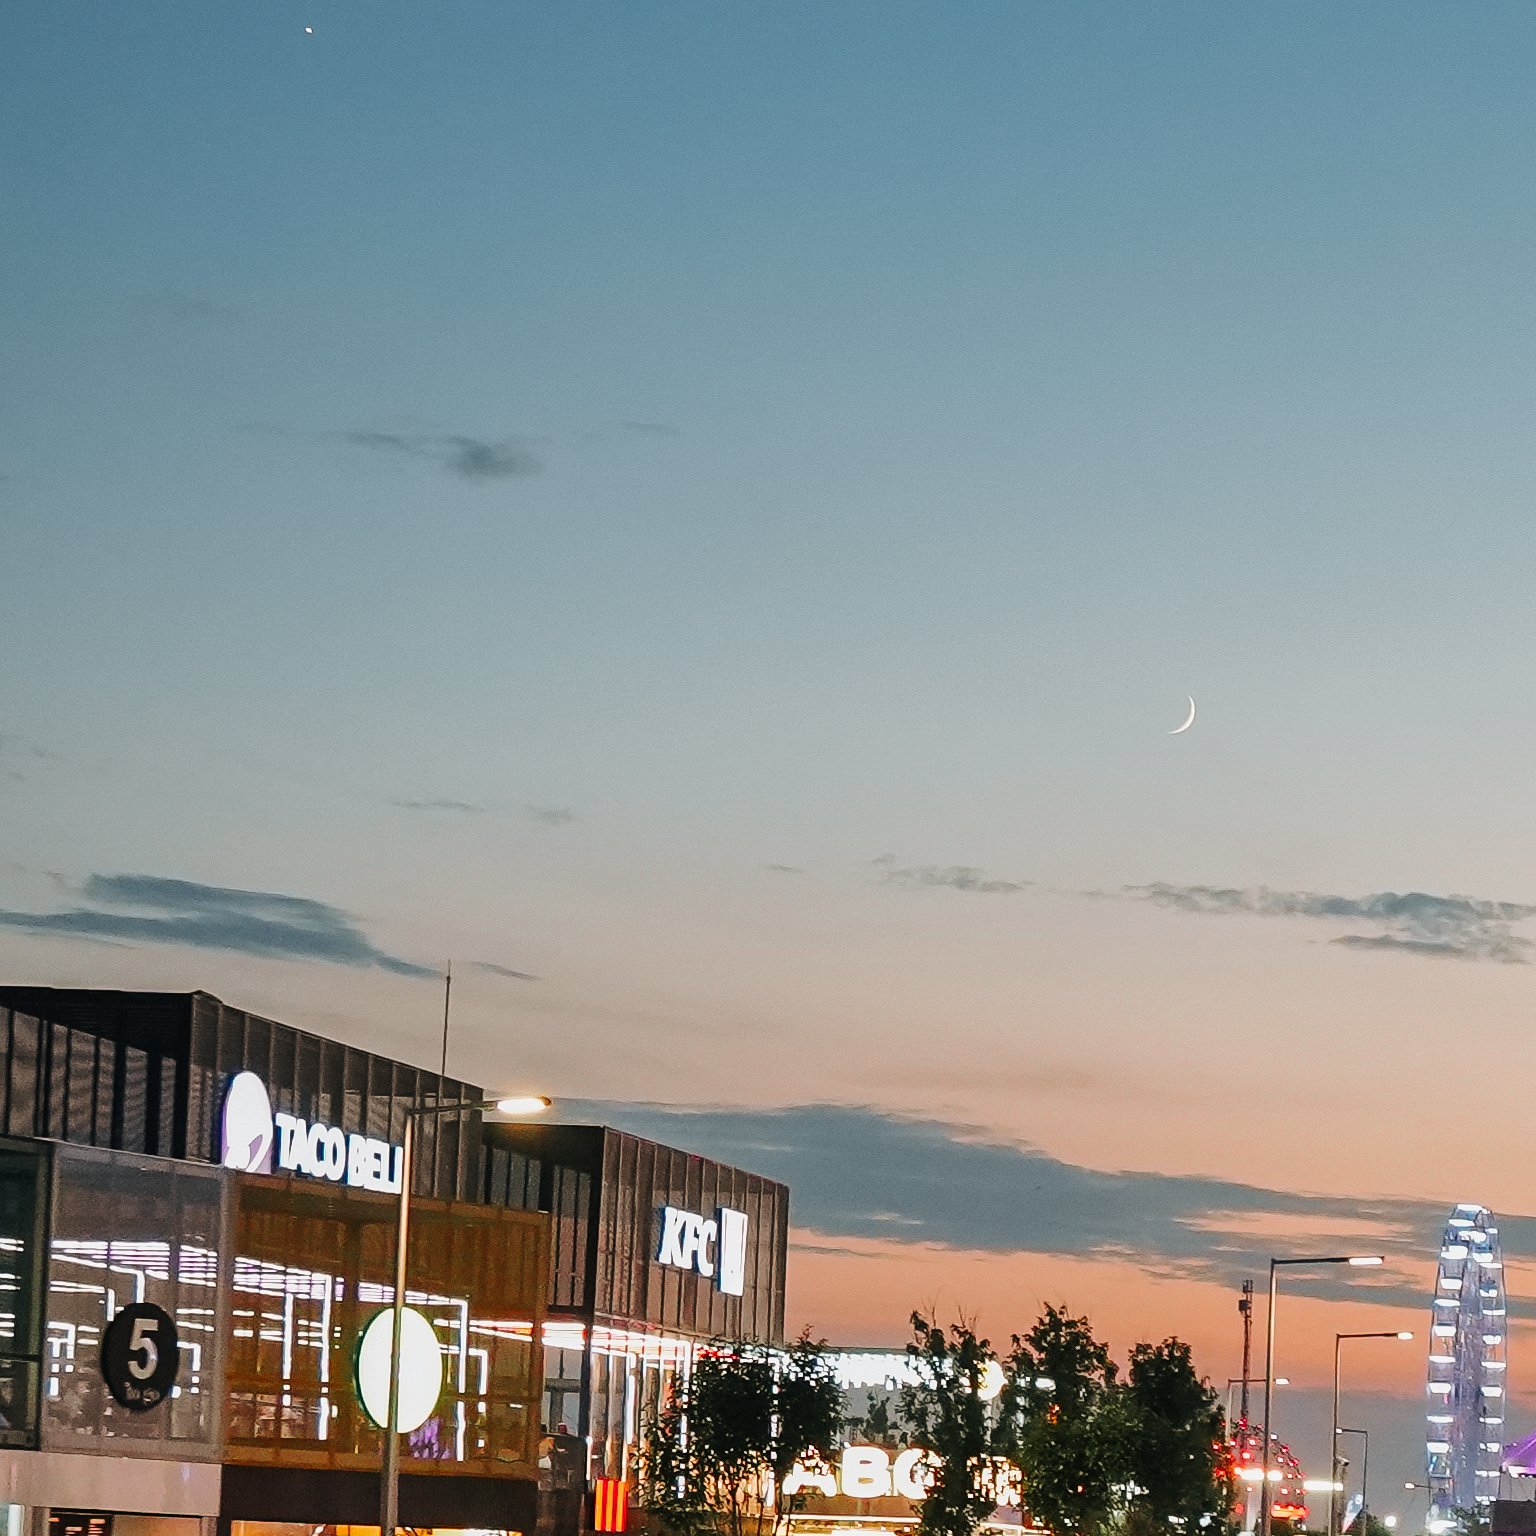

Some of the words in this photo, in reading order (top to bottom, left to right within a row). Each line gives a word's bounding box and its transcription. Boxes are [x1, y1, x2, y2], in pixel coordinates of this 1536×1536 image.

[276, 1112, 346, 1181] TACO
[658, 1206, 718, 1277] KFC
[128, 1318, 158, 1380] 5
